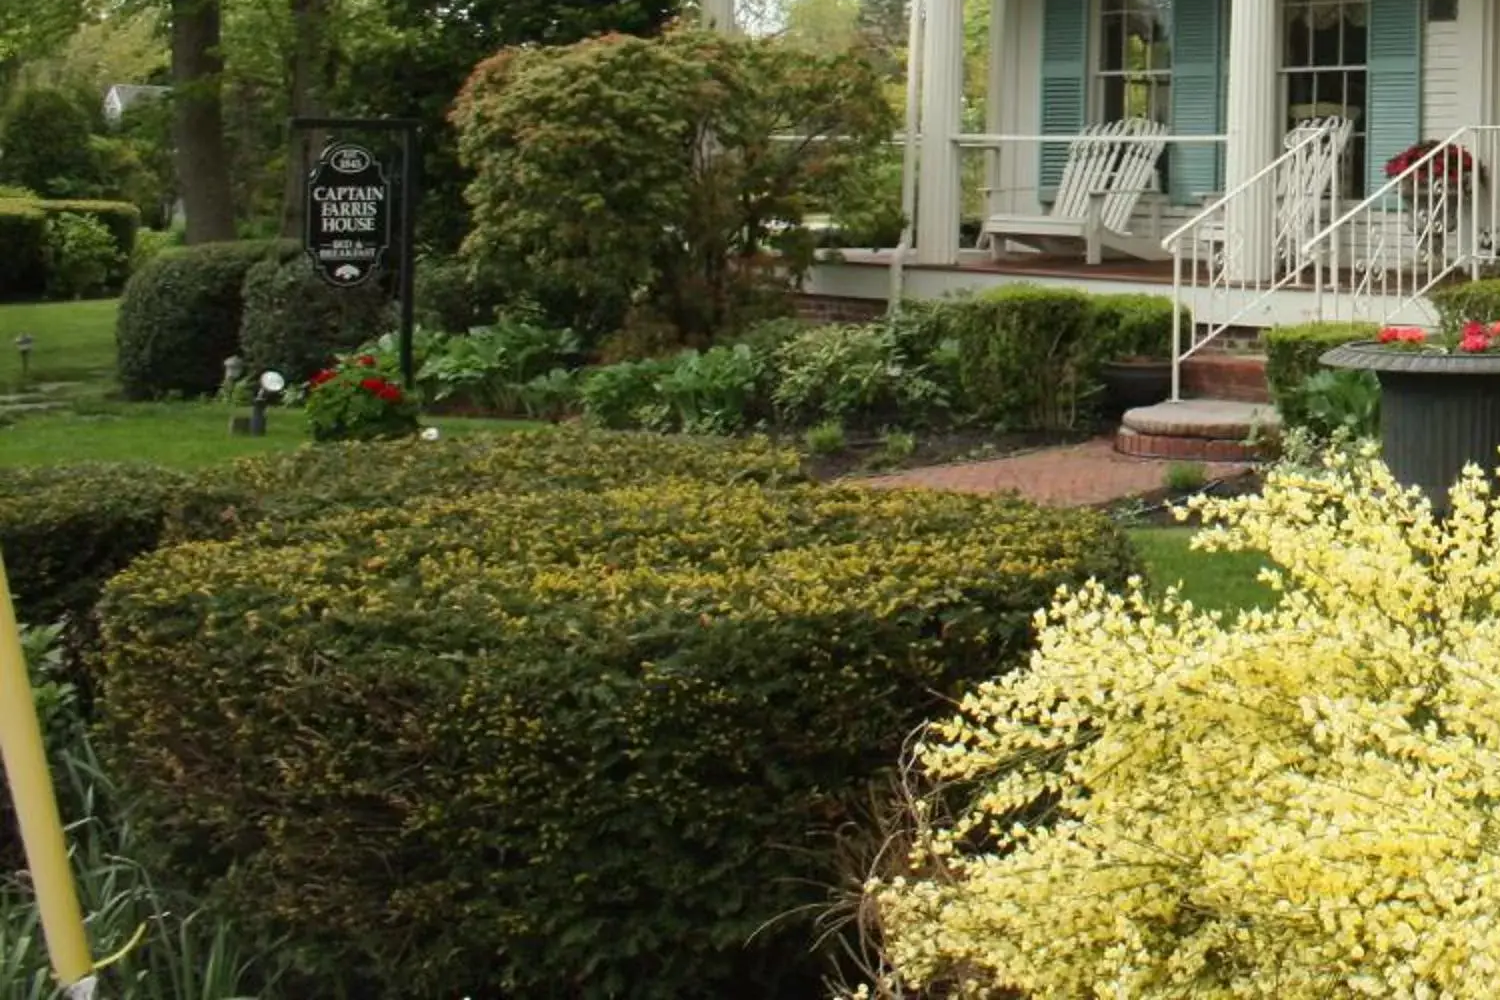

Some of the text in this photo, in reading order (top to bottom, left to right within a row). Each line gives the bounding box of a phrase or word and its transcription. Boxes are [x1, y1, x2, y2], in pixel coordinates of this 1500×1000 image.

[313, 187, 384, 200] CAPTAIN
[321, 201, 377, 216] FARRIS
[321, 217, 376, 231] HOUSE
